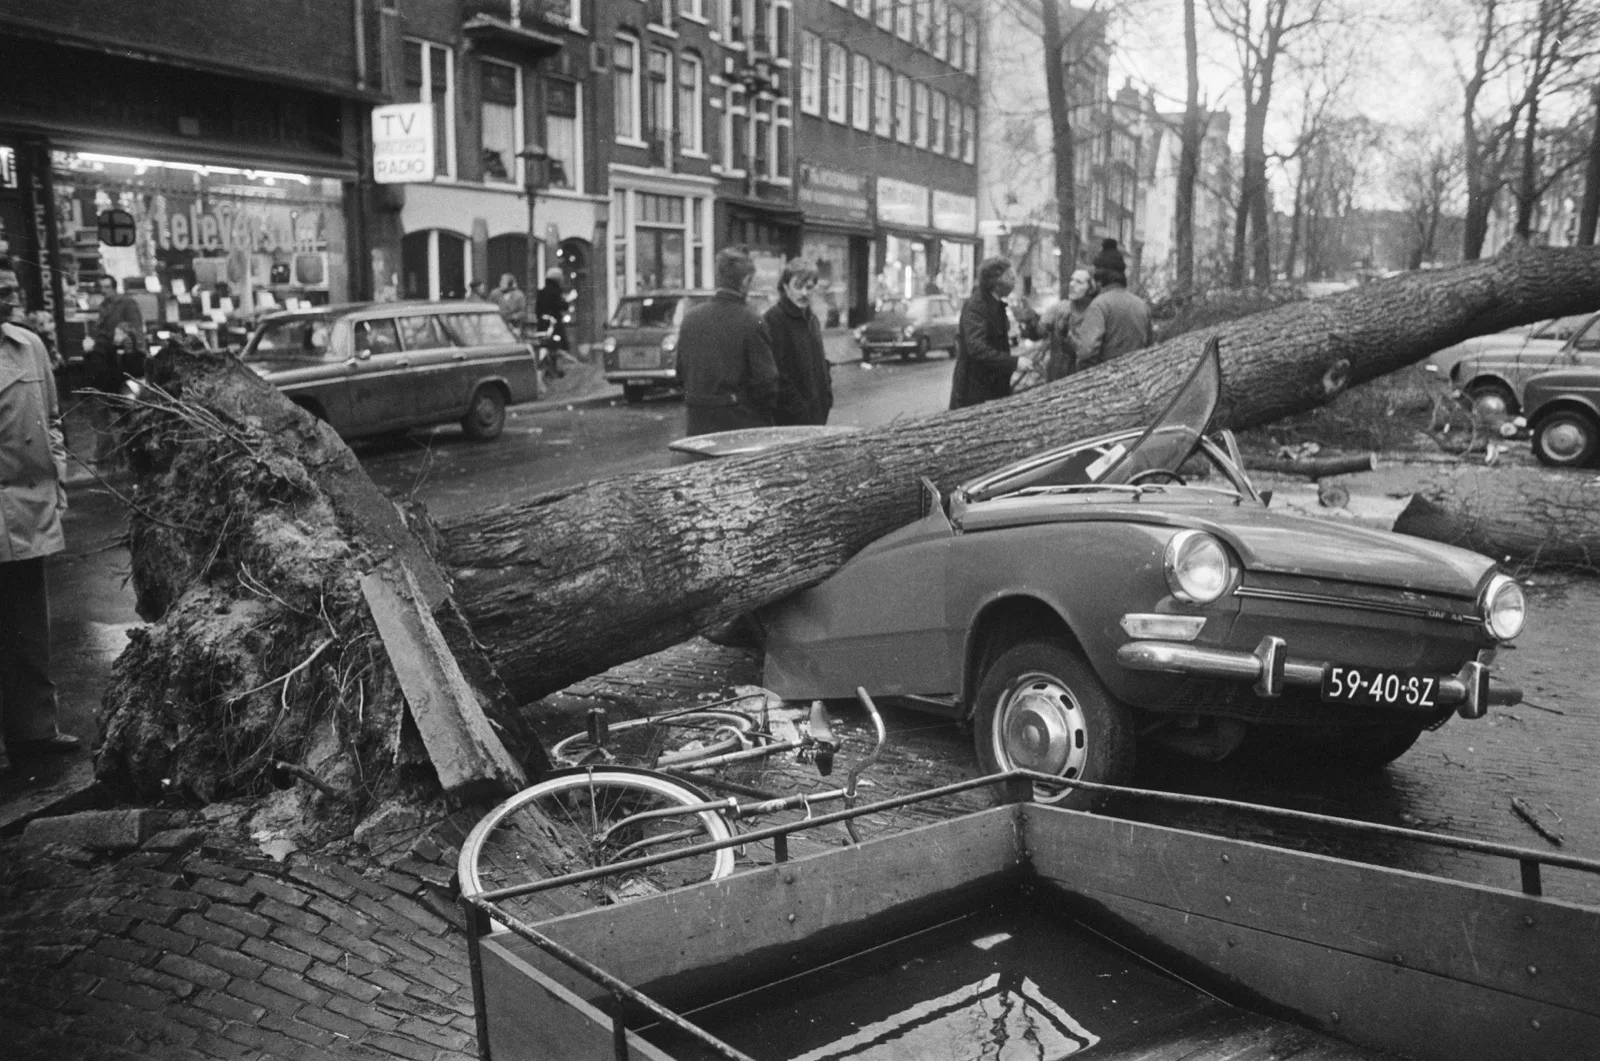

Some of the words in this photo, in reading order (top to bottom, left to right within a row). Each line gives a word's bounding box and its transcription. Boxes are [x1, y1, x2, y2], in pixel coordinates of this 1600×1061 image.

[380, 111, 415, 135] TV
[376, 158, 425, 174] RADIO
[1329, 667, 1434, 706] 59-40-SZ
